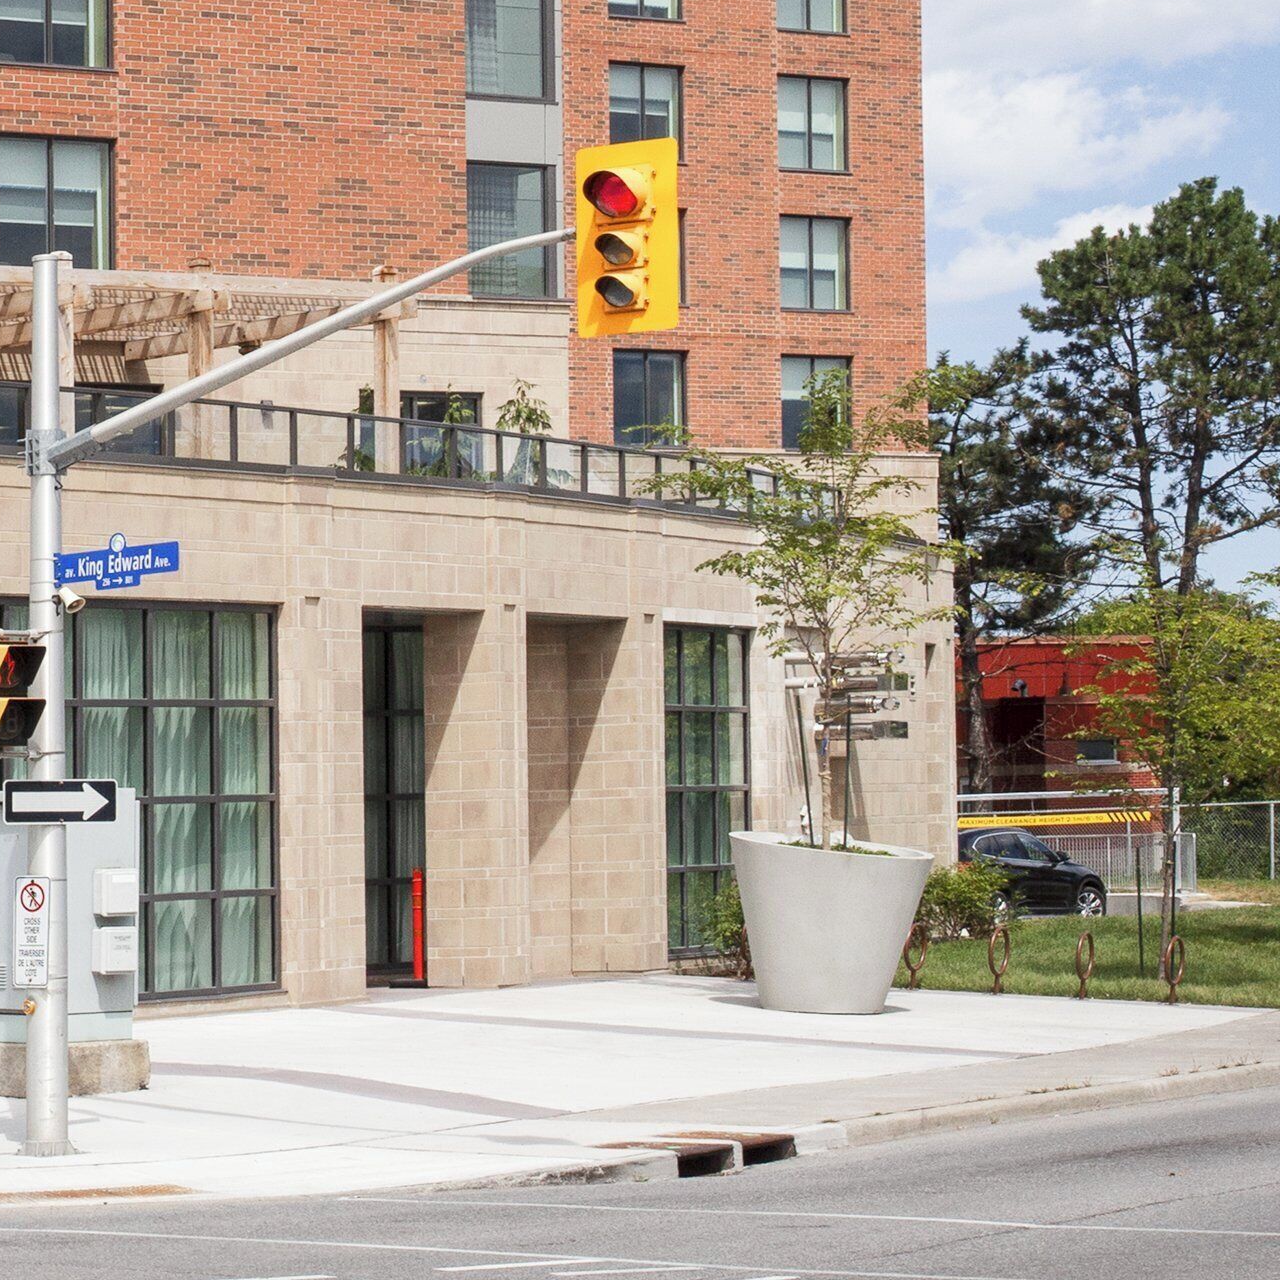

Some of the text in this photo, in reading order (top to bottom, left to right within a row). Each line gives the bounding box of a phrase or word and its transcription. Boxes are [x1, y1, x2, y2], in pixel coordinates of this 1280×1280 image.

[78, 557, 103, 580] King
[108, 549, 152, 573] Edward
[154, 556, 171, 568] Ave.
